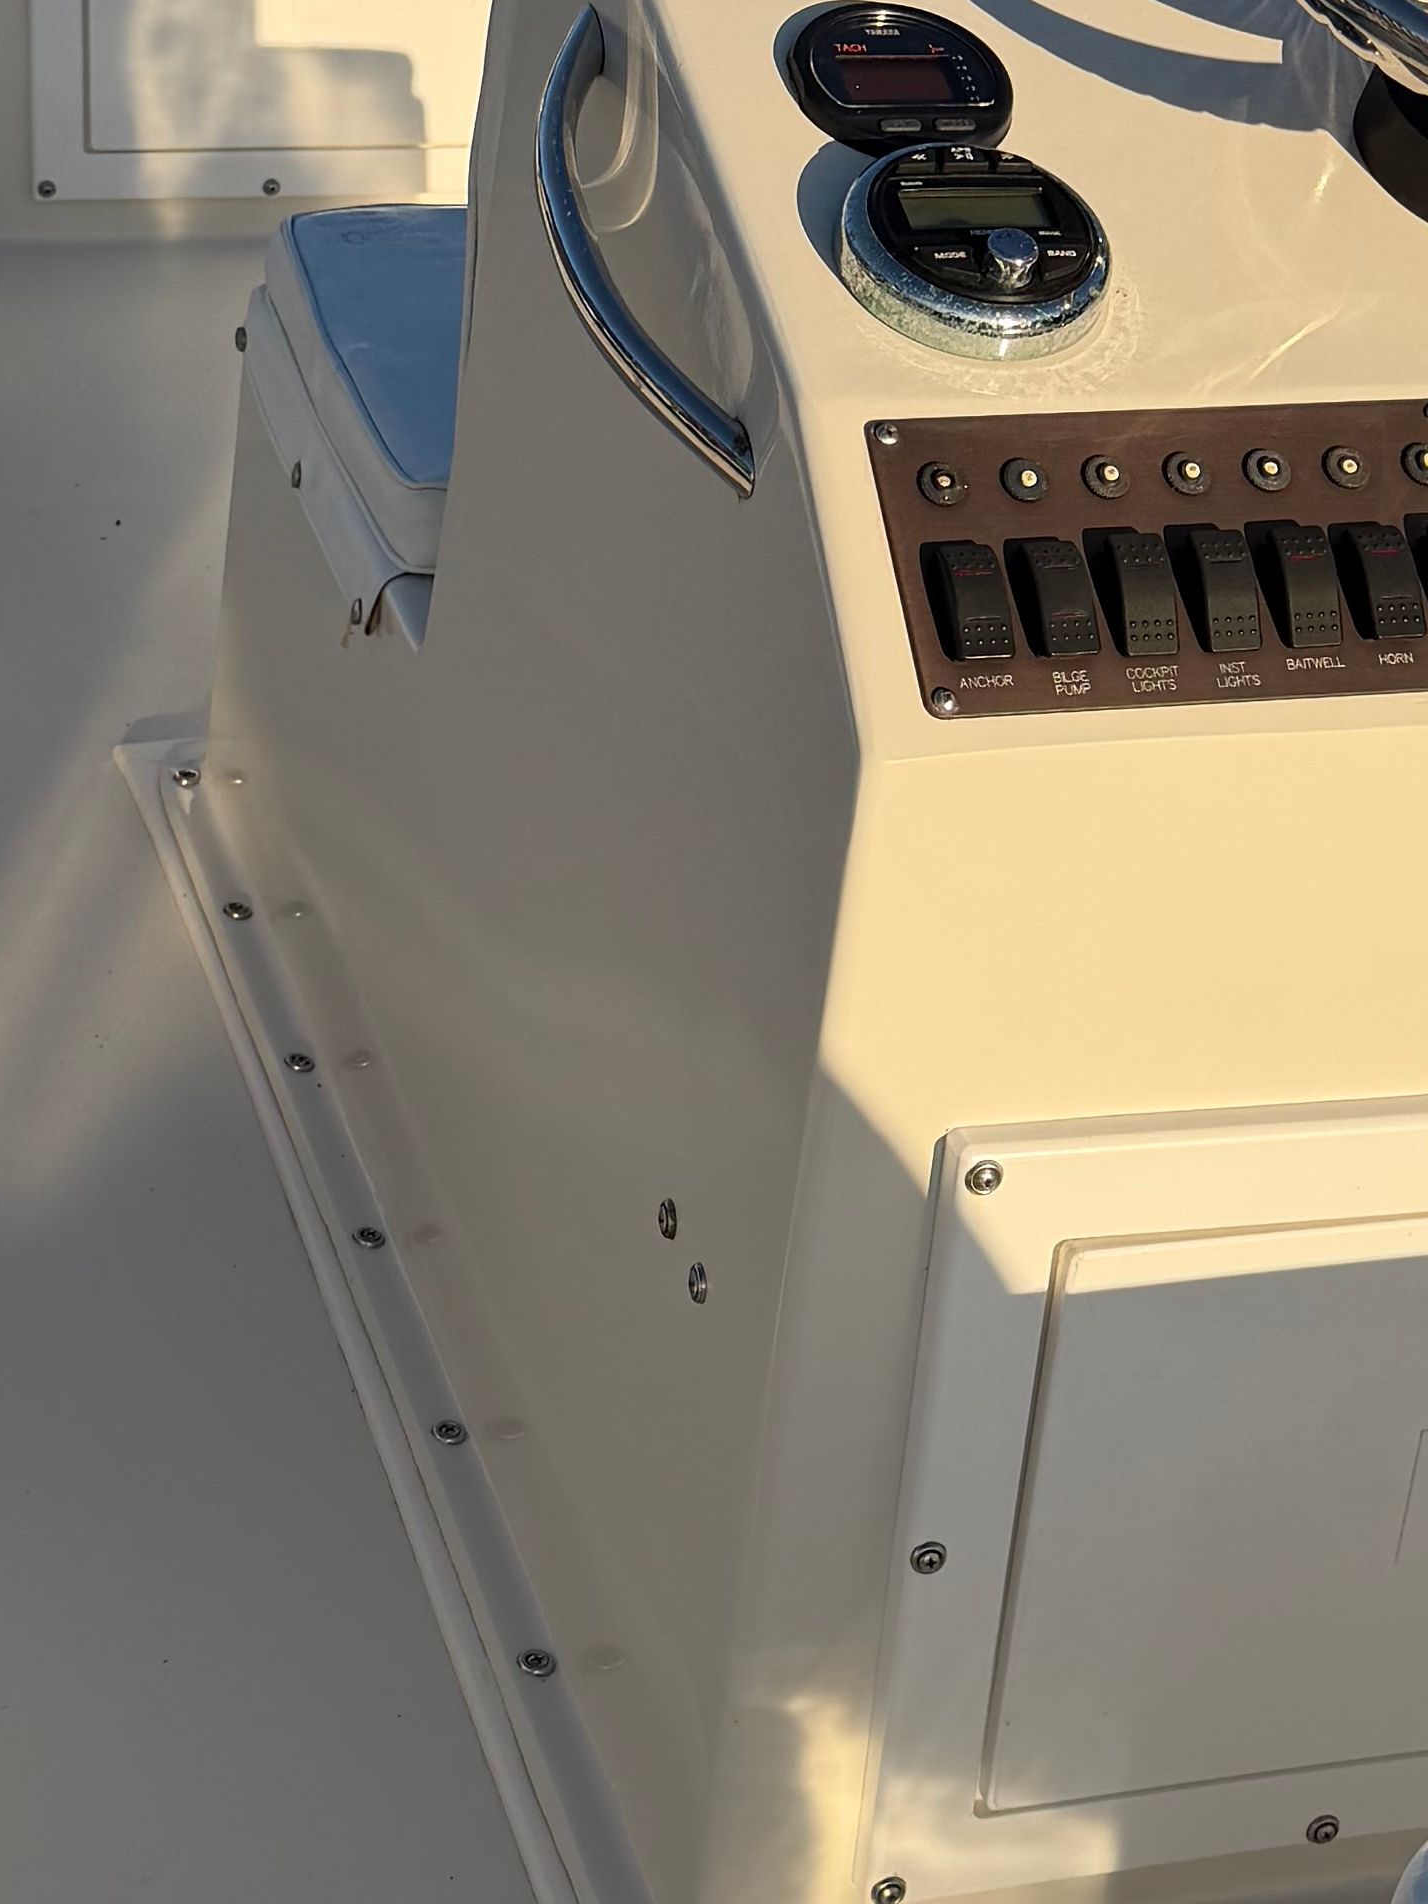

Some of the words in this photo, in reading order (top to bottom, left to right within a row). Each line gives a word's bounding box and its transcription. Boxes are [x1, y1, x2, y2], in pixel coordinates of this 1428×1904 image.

[934, 250, 967, 260] MODE
[1046, 248, 1077, 258] BAND
[1286, 656, 1345, 671] BAITWELL
[1378, 652, 1414, 665] HORN
[1126, 665, 1179, 680] COCKPIT
[1219, 661, 1246, 674] INST
[960, 674, 1014, 689] ANCHOR
[1052, 670, 1090, 684] BILGE
[1217, 675, 1261, 688] LIGHTS
[1055, 683, 1092, 696] PUMP
[1131, 679, 1177, 693] LIGHTS
